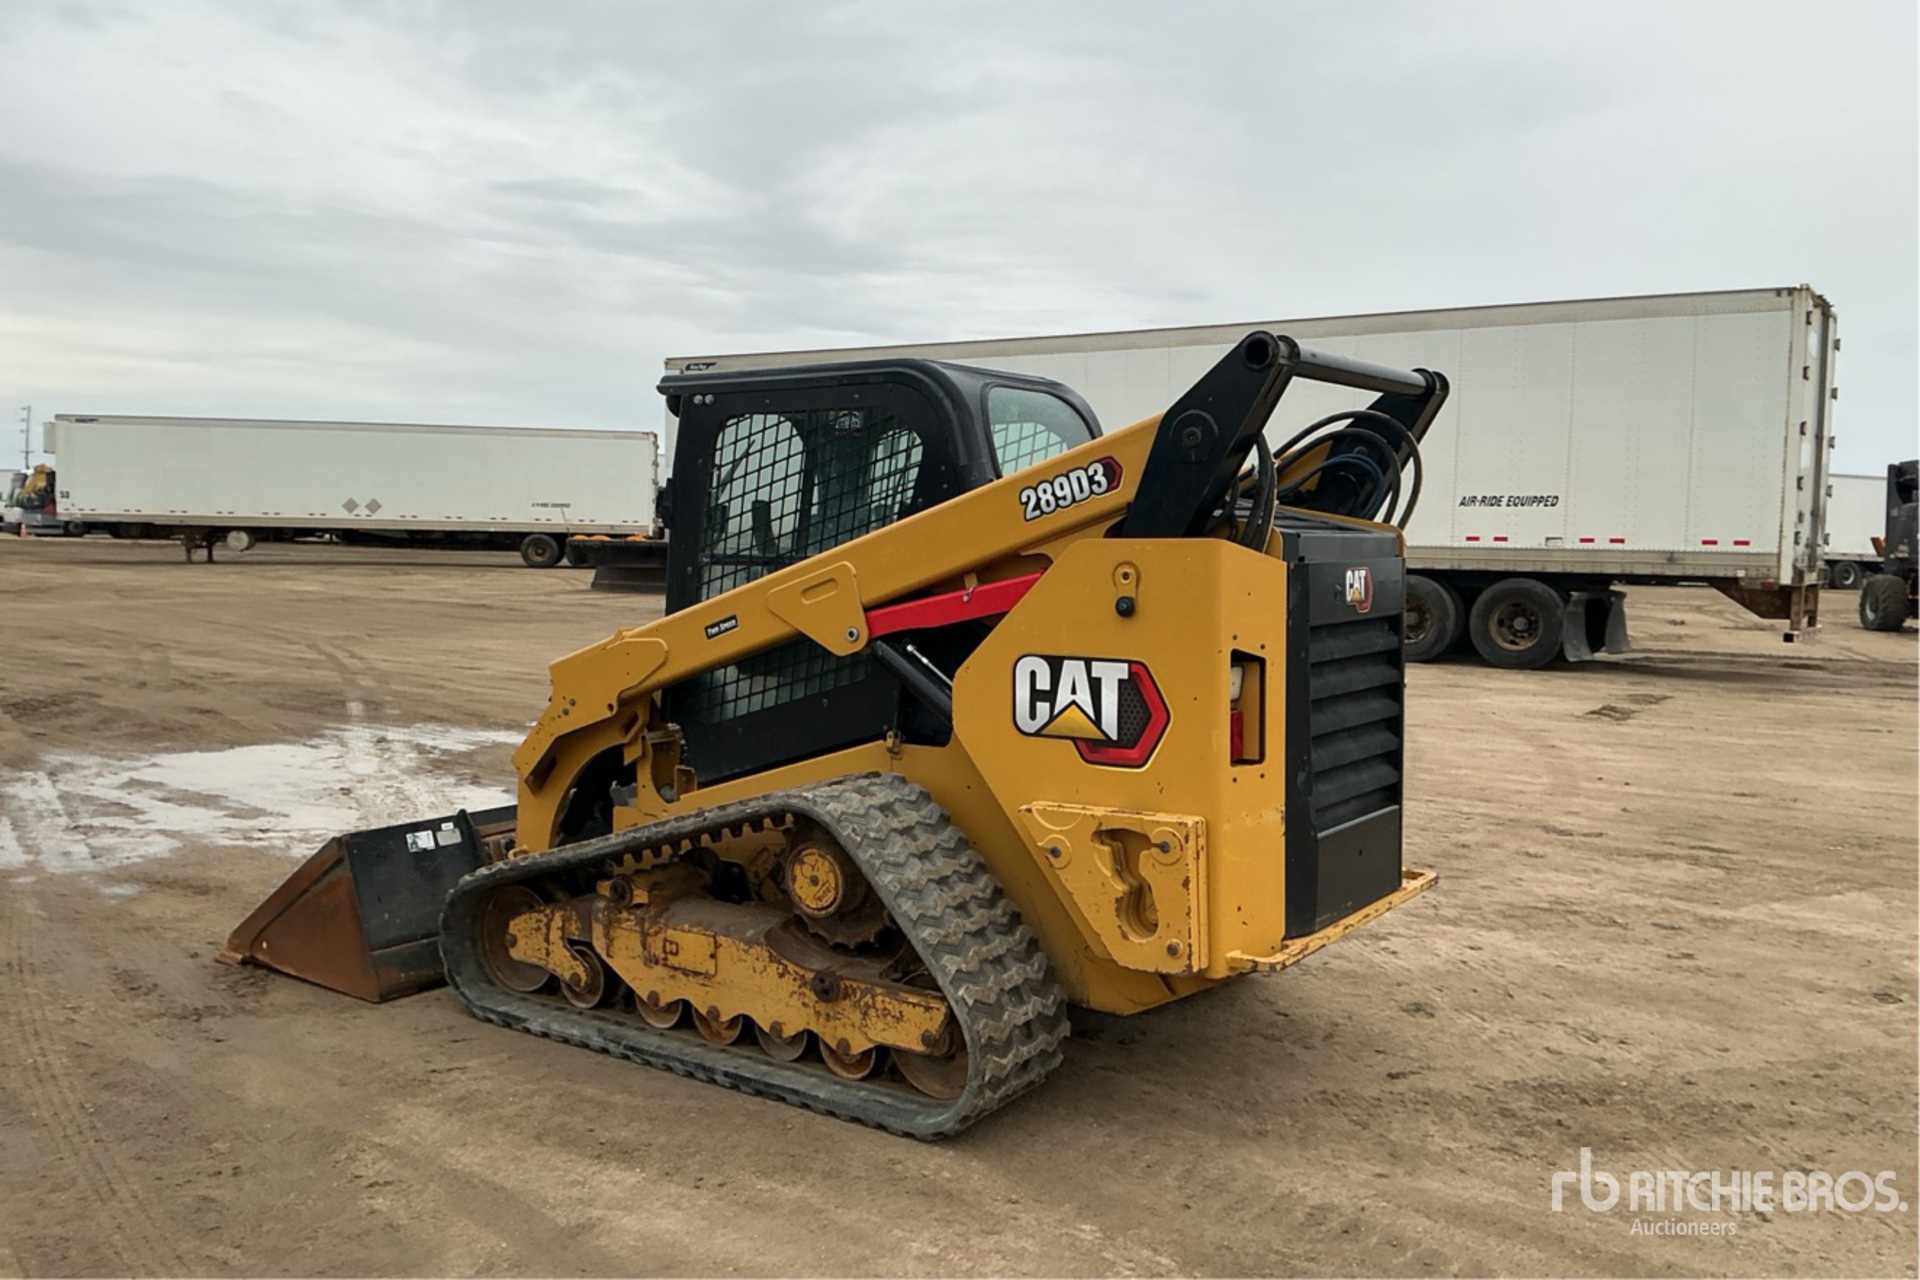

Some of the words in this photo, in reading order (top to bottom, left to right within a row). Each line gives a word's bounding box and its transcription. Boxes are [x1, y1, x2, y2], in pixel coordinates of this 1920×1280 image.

[1020, 462, 1108, 520] 289D3
[1459, 495, 1505, 507] AIR-RIDE
[1506, 495, 1559, 507] EQUIPPED
[1346, 569, 1367, 602] CAT
[1015, 656, 1129, 741] CAT
